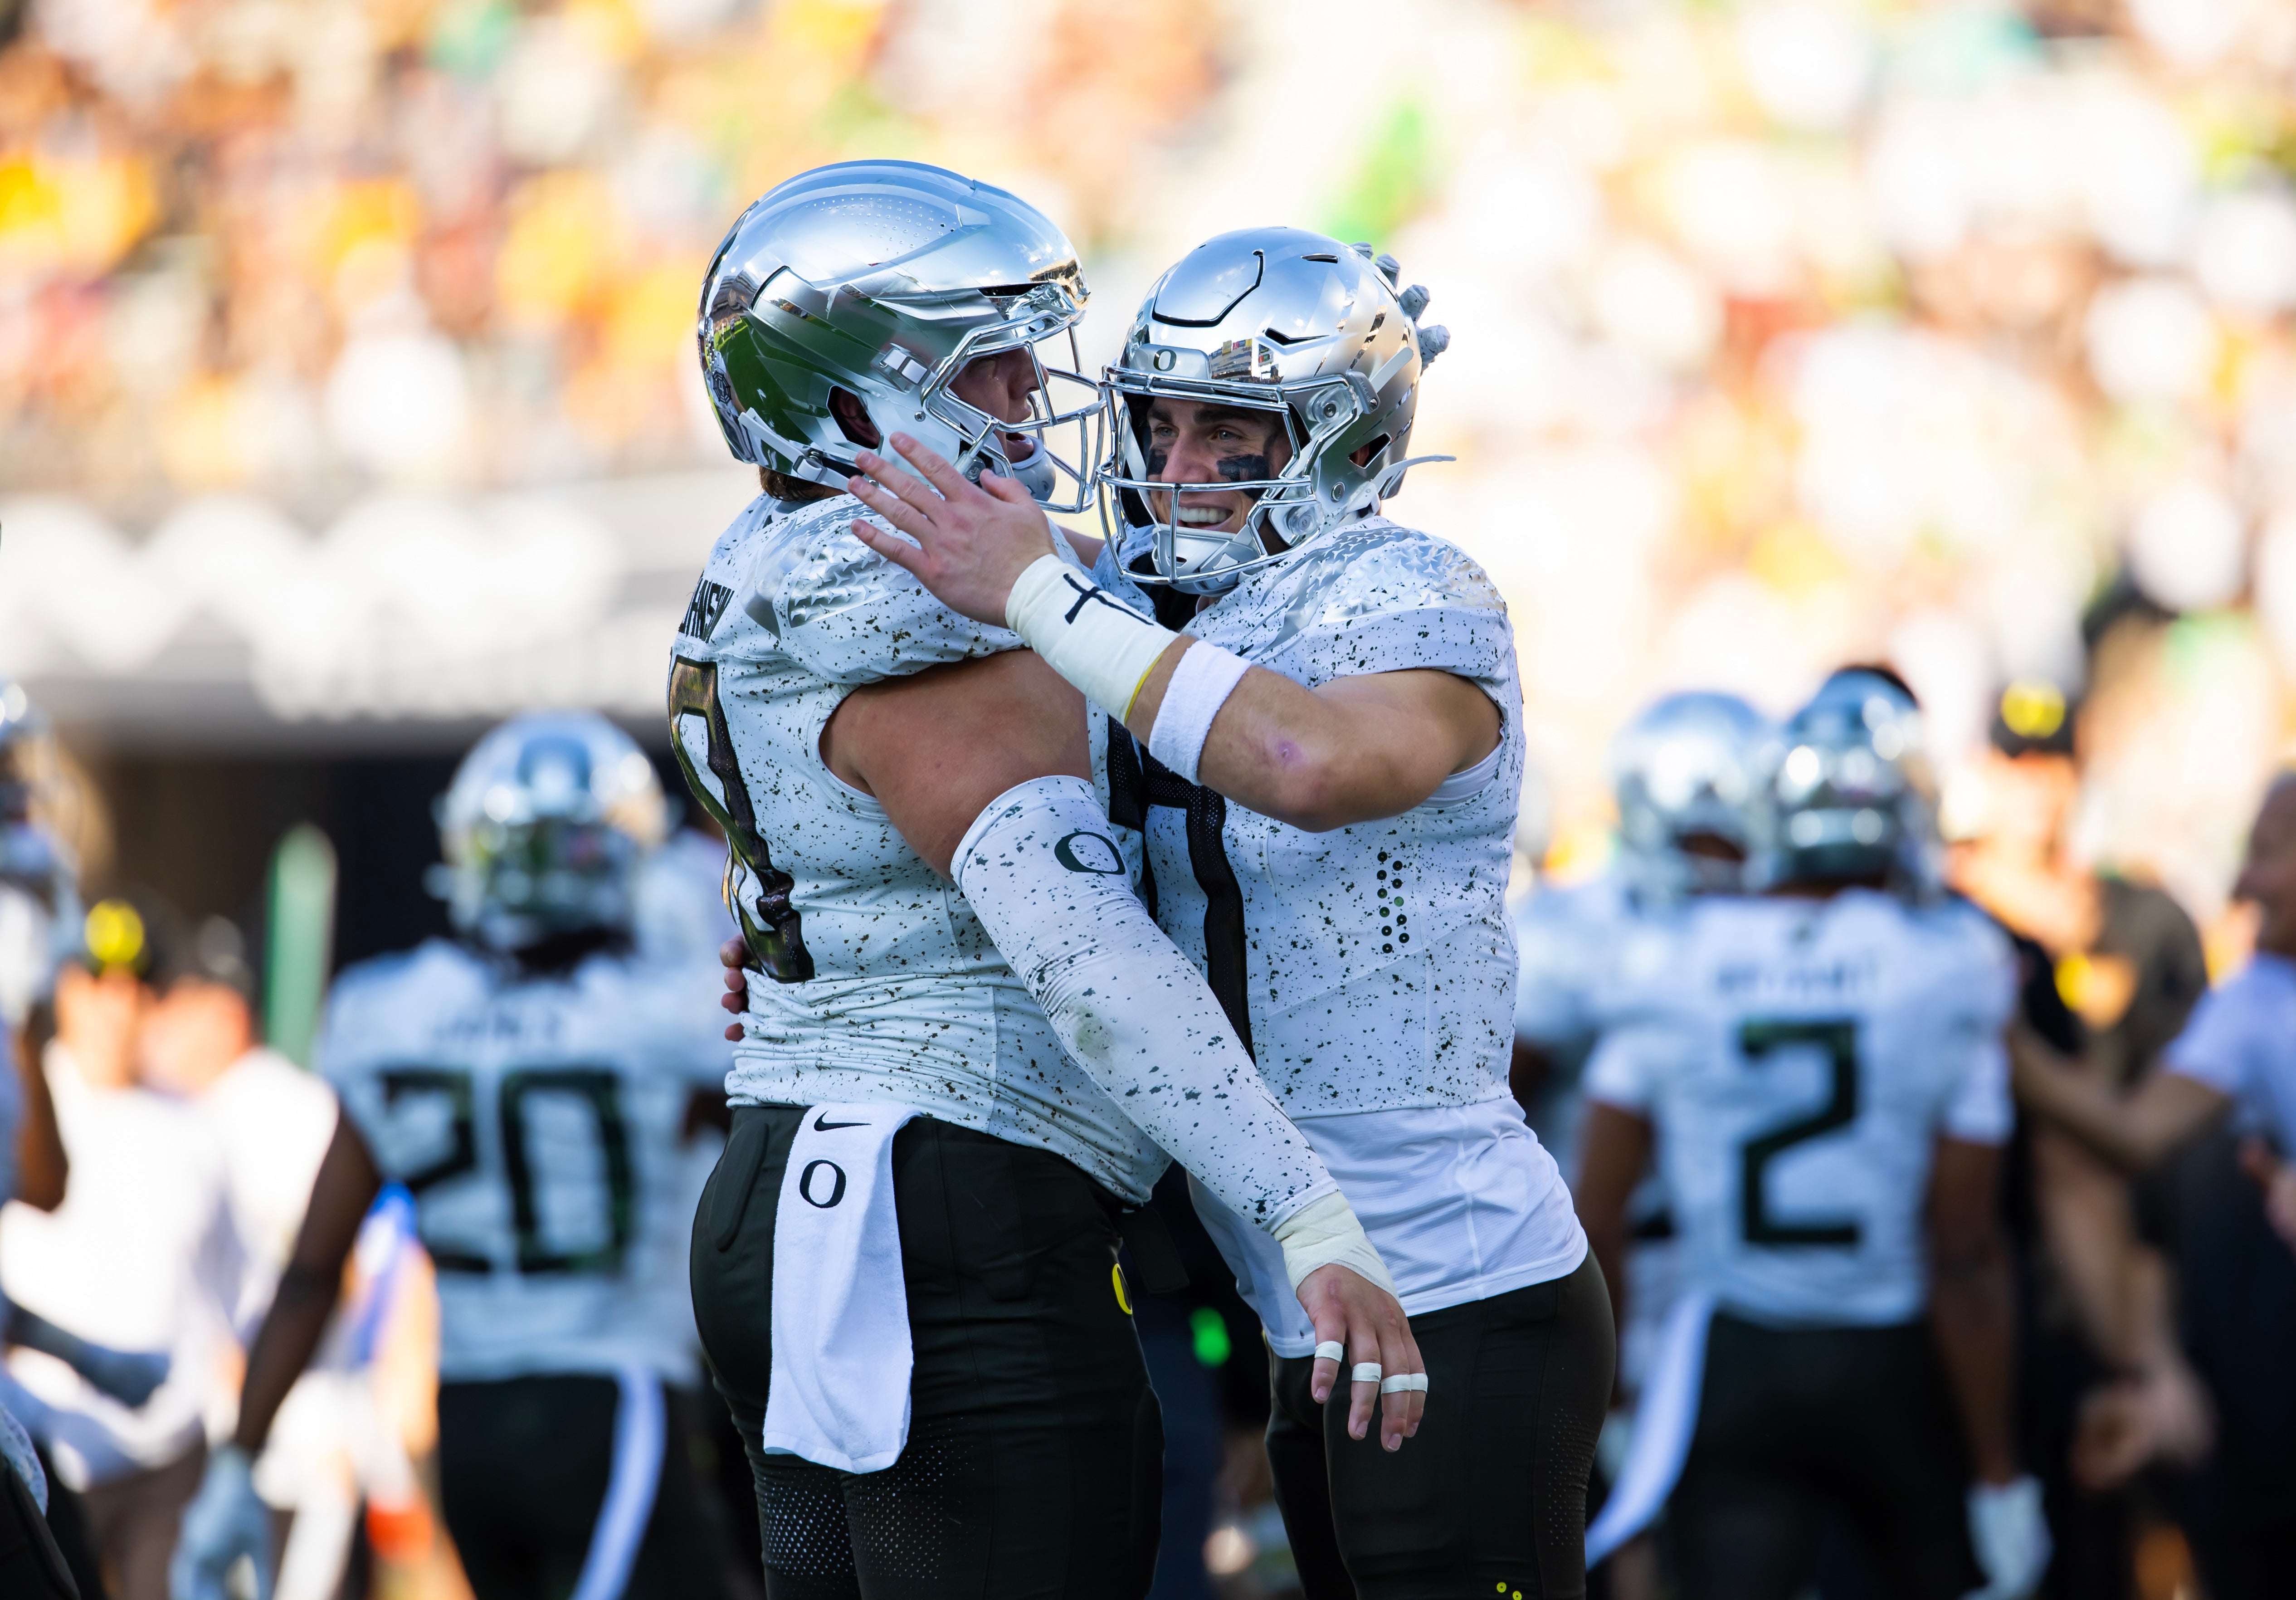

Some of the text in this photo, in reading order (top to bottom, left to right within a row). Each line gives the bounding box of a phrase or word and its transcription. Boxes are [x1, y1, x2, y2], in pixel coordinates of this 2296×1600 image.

[1153, 349, 1177, 372] O
[1054, 831, 1126, 875] O
[1739, 1018, 1864, 1245] 2
[376, 1066, 633, 1273] 20
[799, 1159, 846, 1209] O
